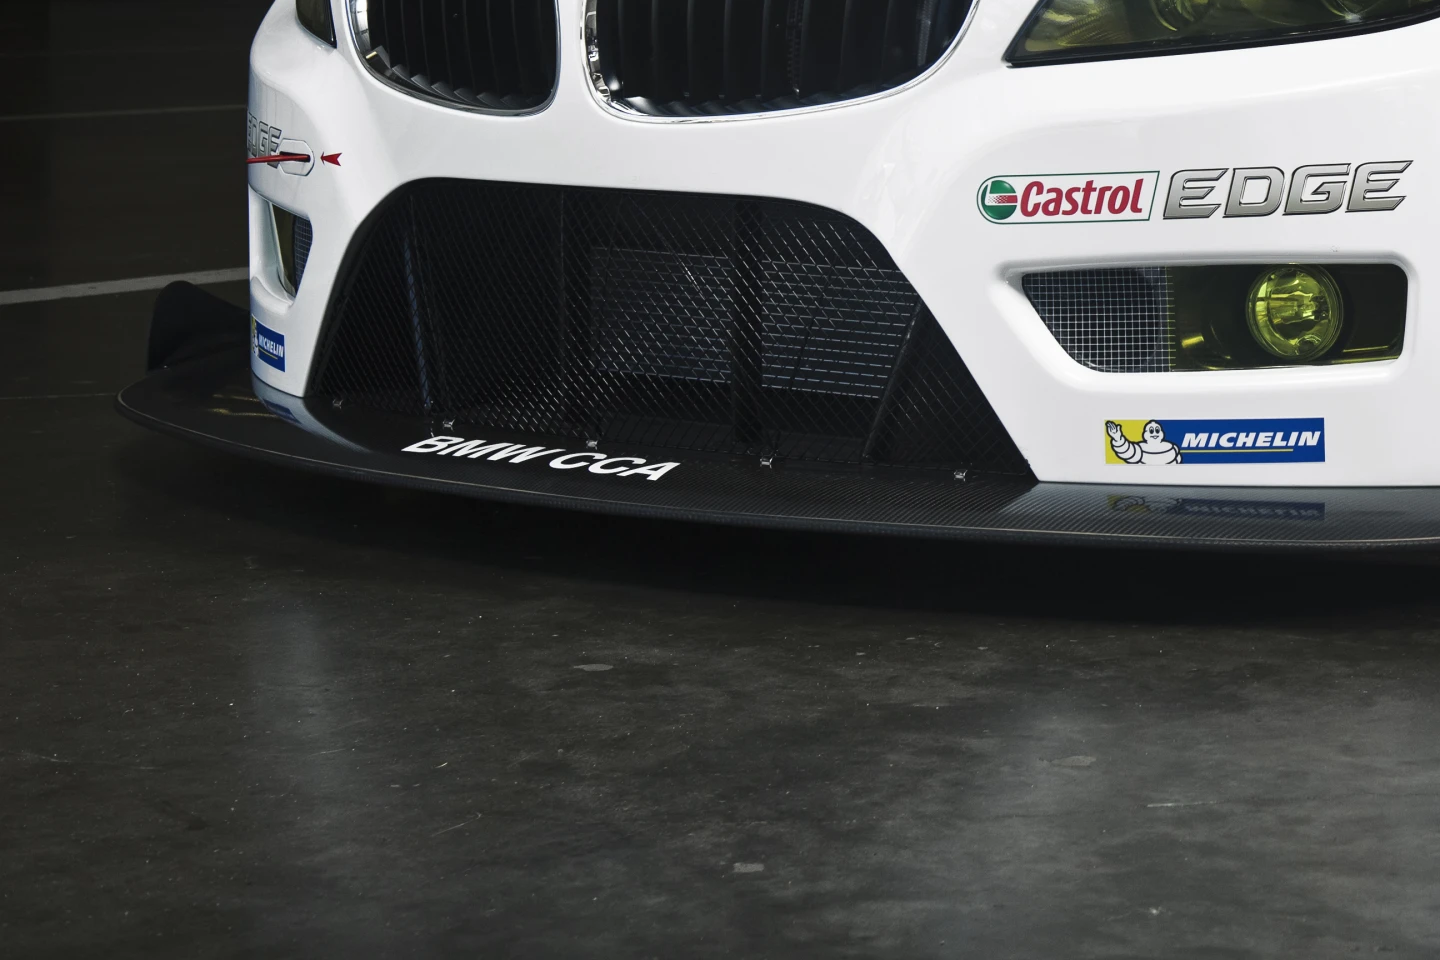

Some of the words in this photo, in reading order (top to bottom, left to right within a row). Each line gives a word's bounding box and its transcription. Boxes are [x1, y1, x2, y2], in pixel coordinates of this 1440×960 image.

[1019, 178, 1144, 218] Castrol
[1163, 160, 1414, 221] EDGE
[258, 333, 284, 358] MICHELIN
[1181, 431, 1322, 448] MICHELIN
[401, 435, 567, 464] BMW
[549, 452, 682, 481] CCA
